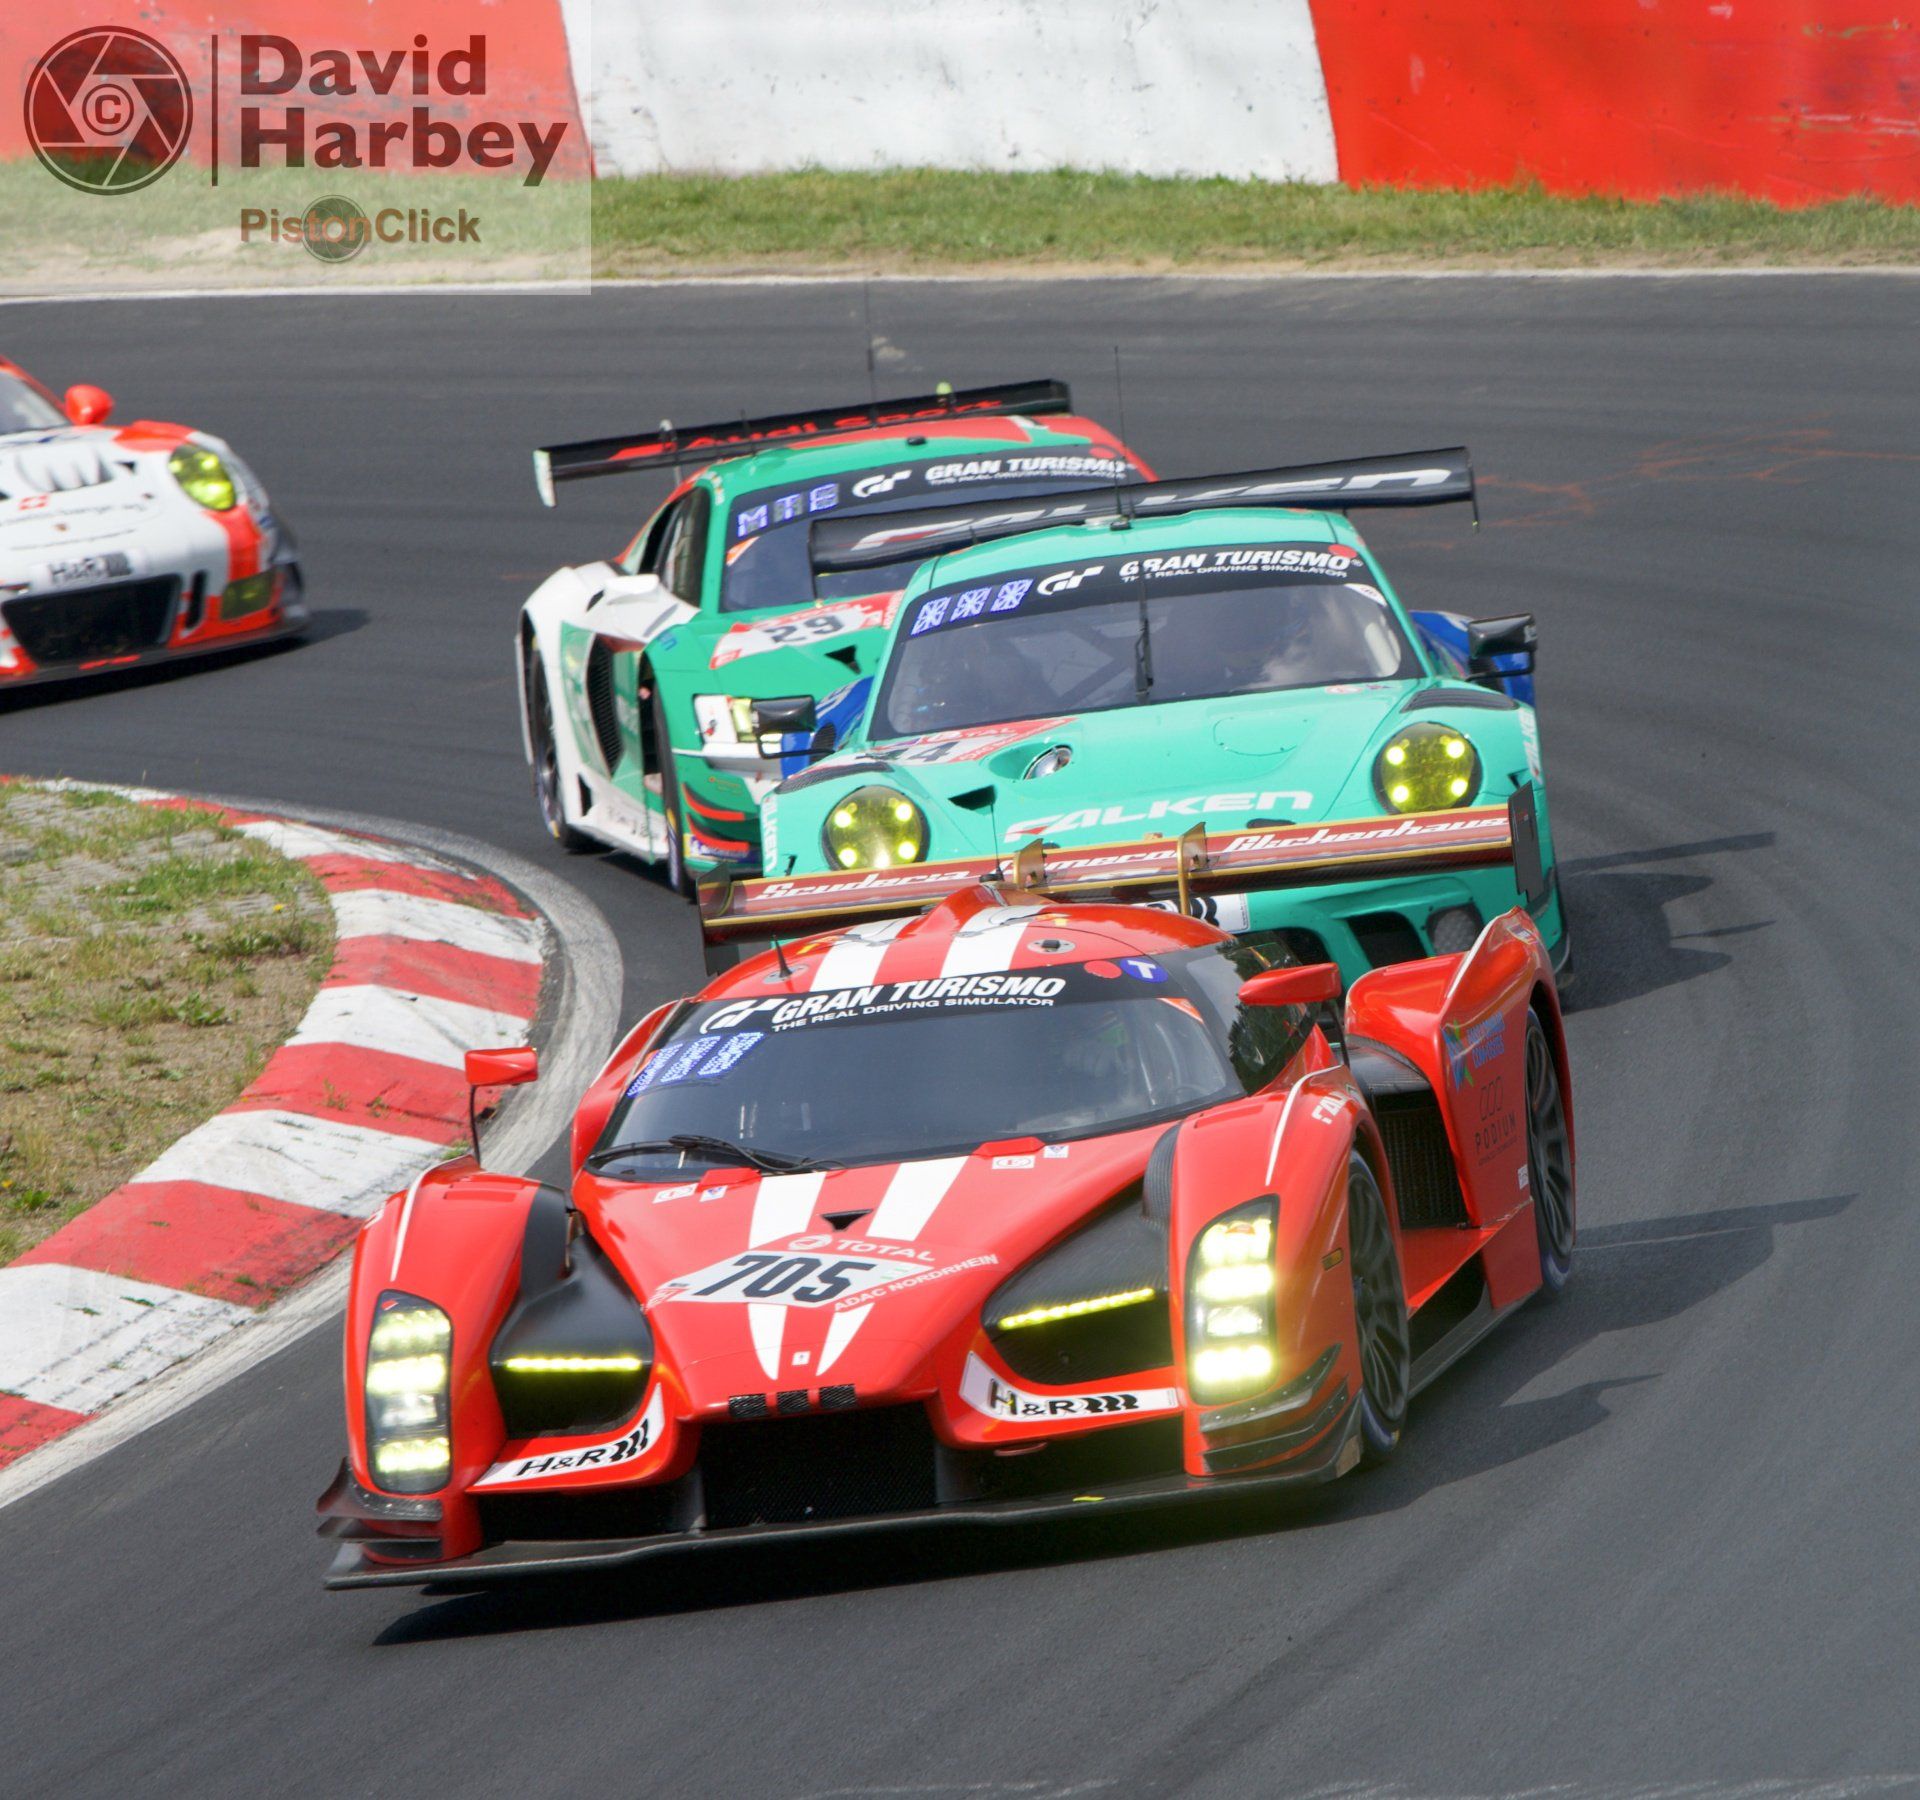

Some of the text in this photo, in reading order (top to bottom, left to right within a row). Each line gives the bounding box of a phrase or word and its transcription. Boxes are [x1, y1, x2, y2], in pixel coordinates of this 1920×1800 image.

[925, 459, 1002, 480] GRAN
[1119, 552, 1207, 577] GRAN
[1154, 568, 1194, 578] REAL
[1197, 565, 1253, 574] DRIVING
[1261, 565, 1348, 578] SIMULATOR
[764, 614, 845, 643] 29
[1003, 790, 1313, 843] FALKEN
[752, 869, 971, 901] Scuderia
[1222, 816, 1509, 854] Glickenhaus
[771, 984, 884, 1025] GRAN
[888, 976, 1066, 1002] TURISMO
[772, 997, 1054, 1033] THE REAL DRIVING SIMULATOR
[1474, 1112, 1517, 1154] PODIUM
[837, 1239, 936, 1262] TOTAL
[691, 1254, 877, 1304] 705
[835, 1254, 1000, 1312] ADAC NORDRHEIN
[990, 1377, 1077, 1416] H&R
[516, 1448, 607, 1477] H&R
